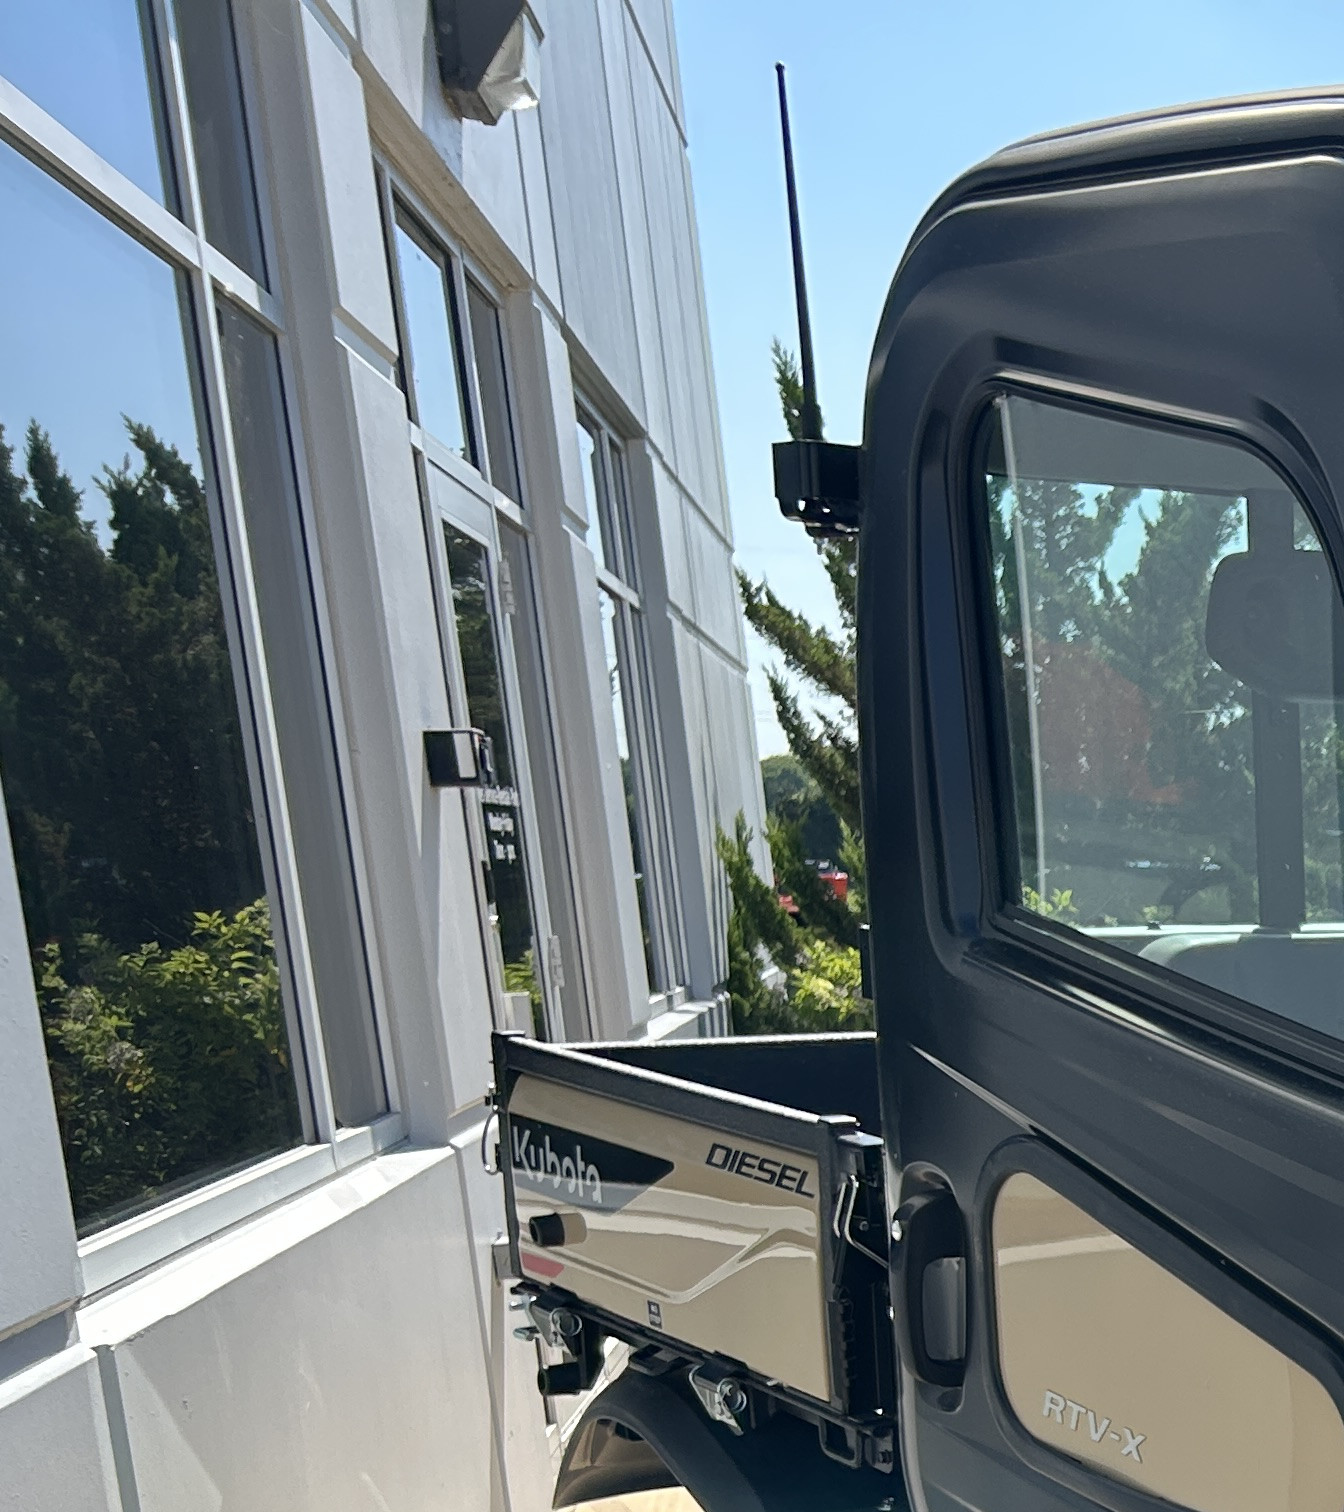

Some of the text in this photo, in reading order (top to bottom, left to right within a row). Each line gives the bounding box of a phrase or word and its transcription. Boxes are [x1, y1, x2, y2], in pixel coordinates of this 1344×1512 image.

[512, 1126, 603, 1204] Kubota
[705, 1142, 815, 1199] DIESEL
[1042, 1389, 1147, 1464] RTV-X
